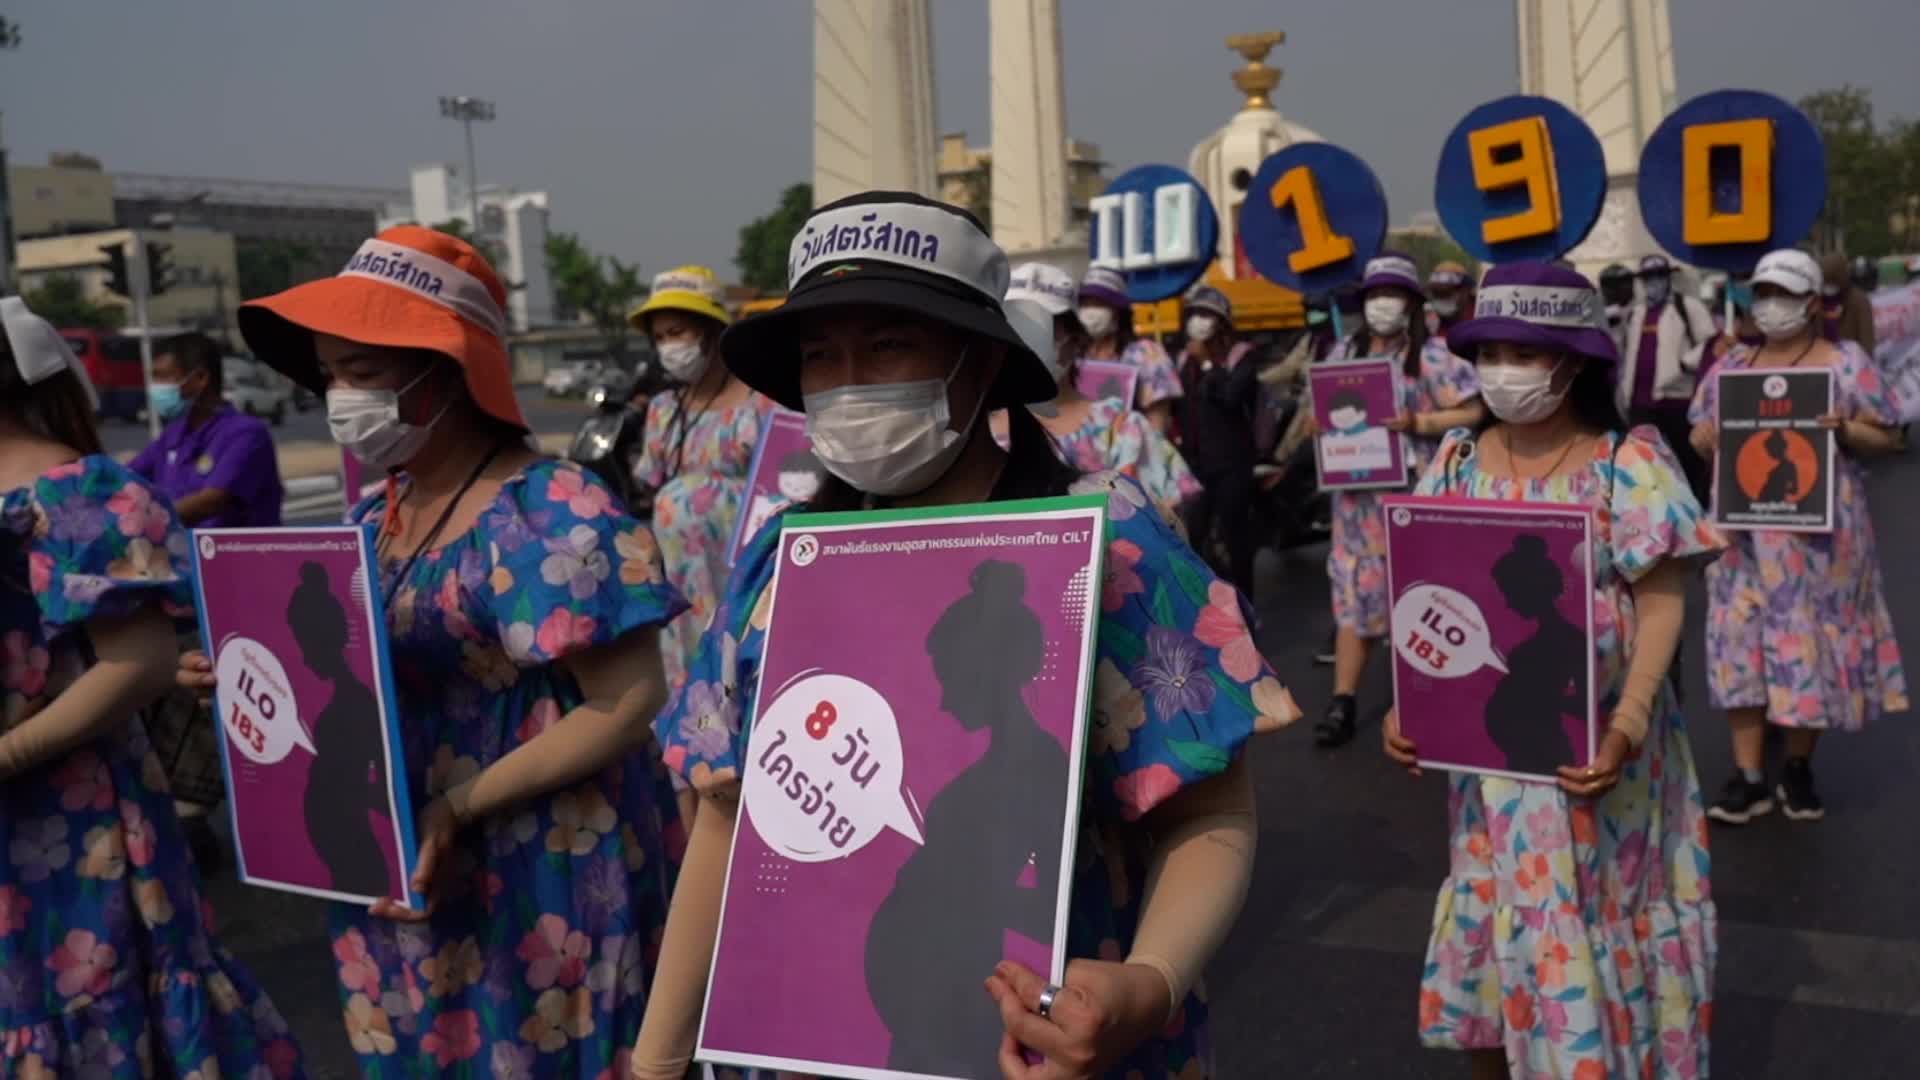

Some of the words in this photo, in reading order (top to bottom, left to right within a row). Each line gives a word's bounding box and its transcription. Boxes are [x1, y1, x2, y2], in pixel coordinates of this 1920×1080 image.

[1468, 115, 1561, 244] 9
[801, 212, 939, 267] วันสตรีสากล
[1272, 166, 1354, 272] 1
[1062, 531, 1090, 544] CILT
[1406, 631, 1449, 670] 183
[1421, 606, 1466, 646] ILO
[238, 667, 276, 721] ILO
[231, 702, 266, 754] 183
[805, 700, 837, 741] 8
[832, 727, 880, 789] วัน
